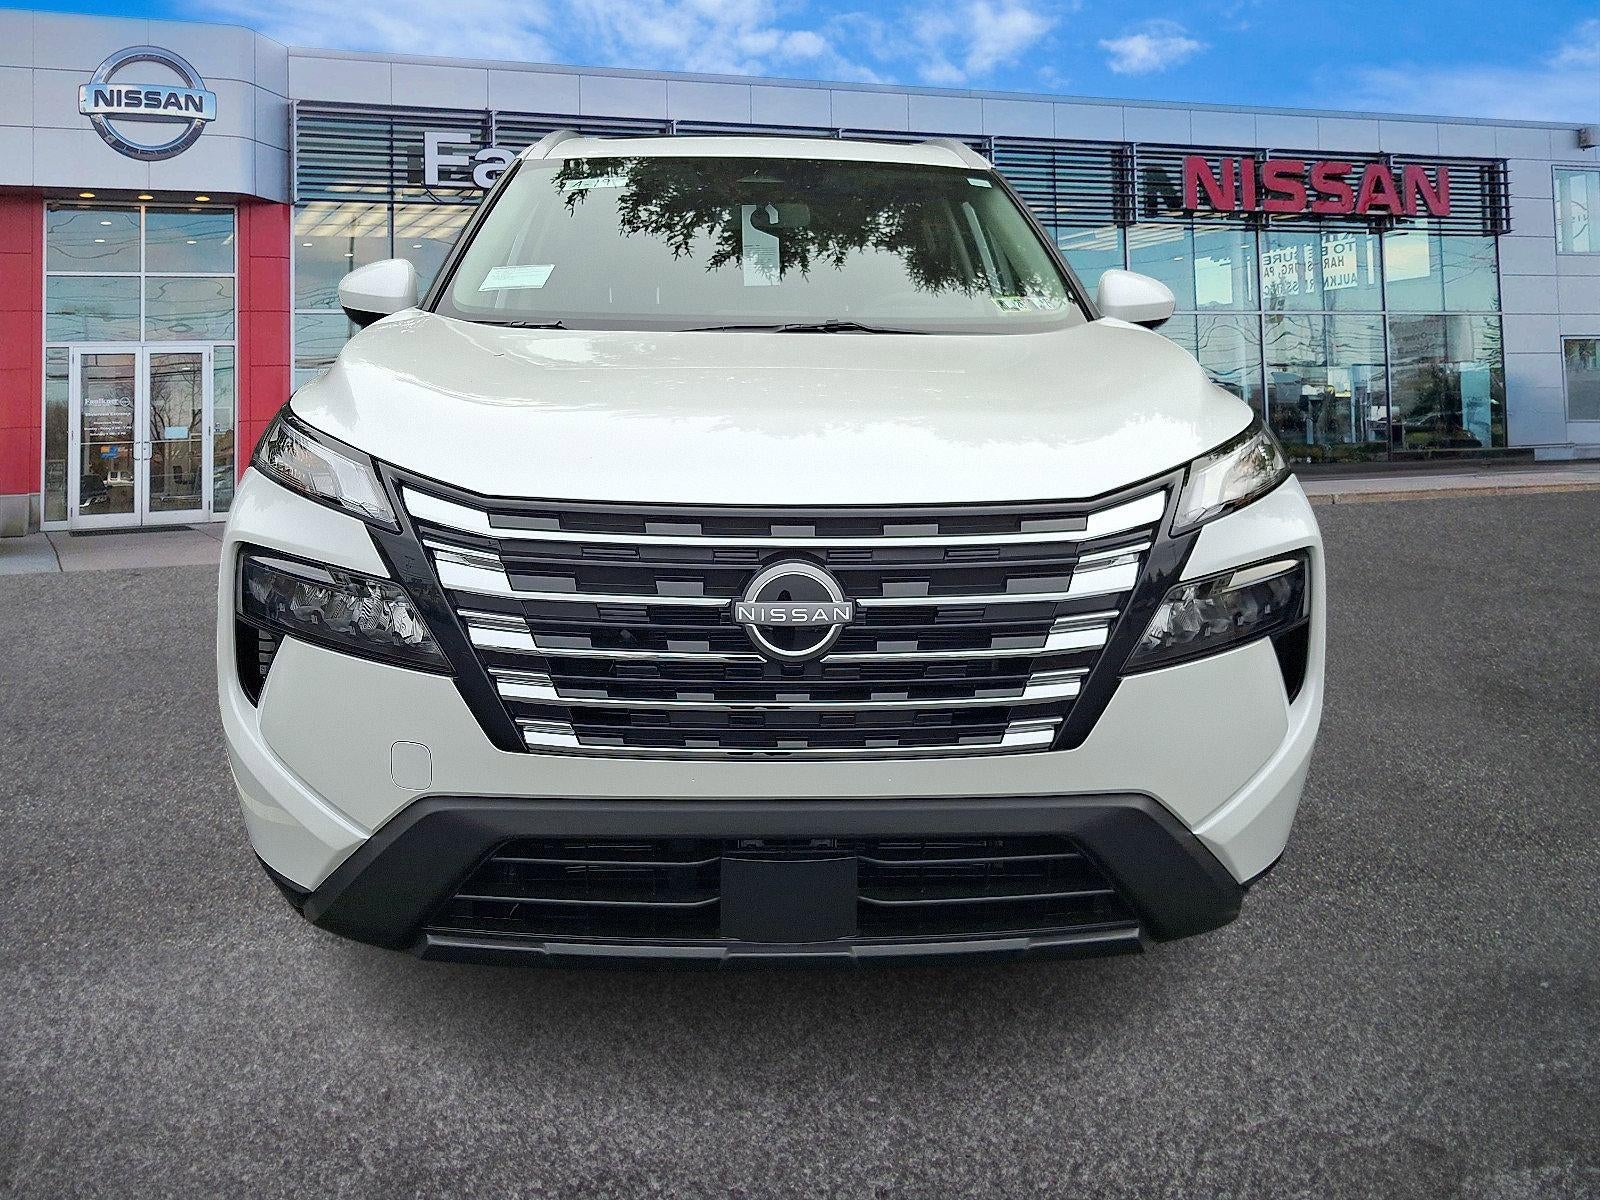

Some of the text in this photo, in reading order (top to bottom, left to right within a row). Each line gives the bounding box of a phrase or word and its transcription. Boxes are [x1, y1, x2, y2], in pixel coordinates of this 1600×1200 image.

[94, 89, 204, 113] NISSAN
[1182, 155, 1451, 217] NISSAN
[738, 607, 850, 622] NISSAN
